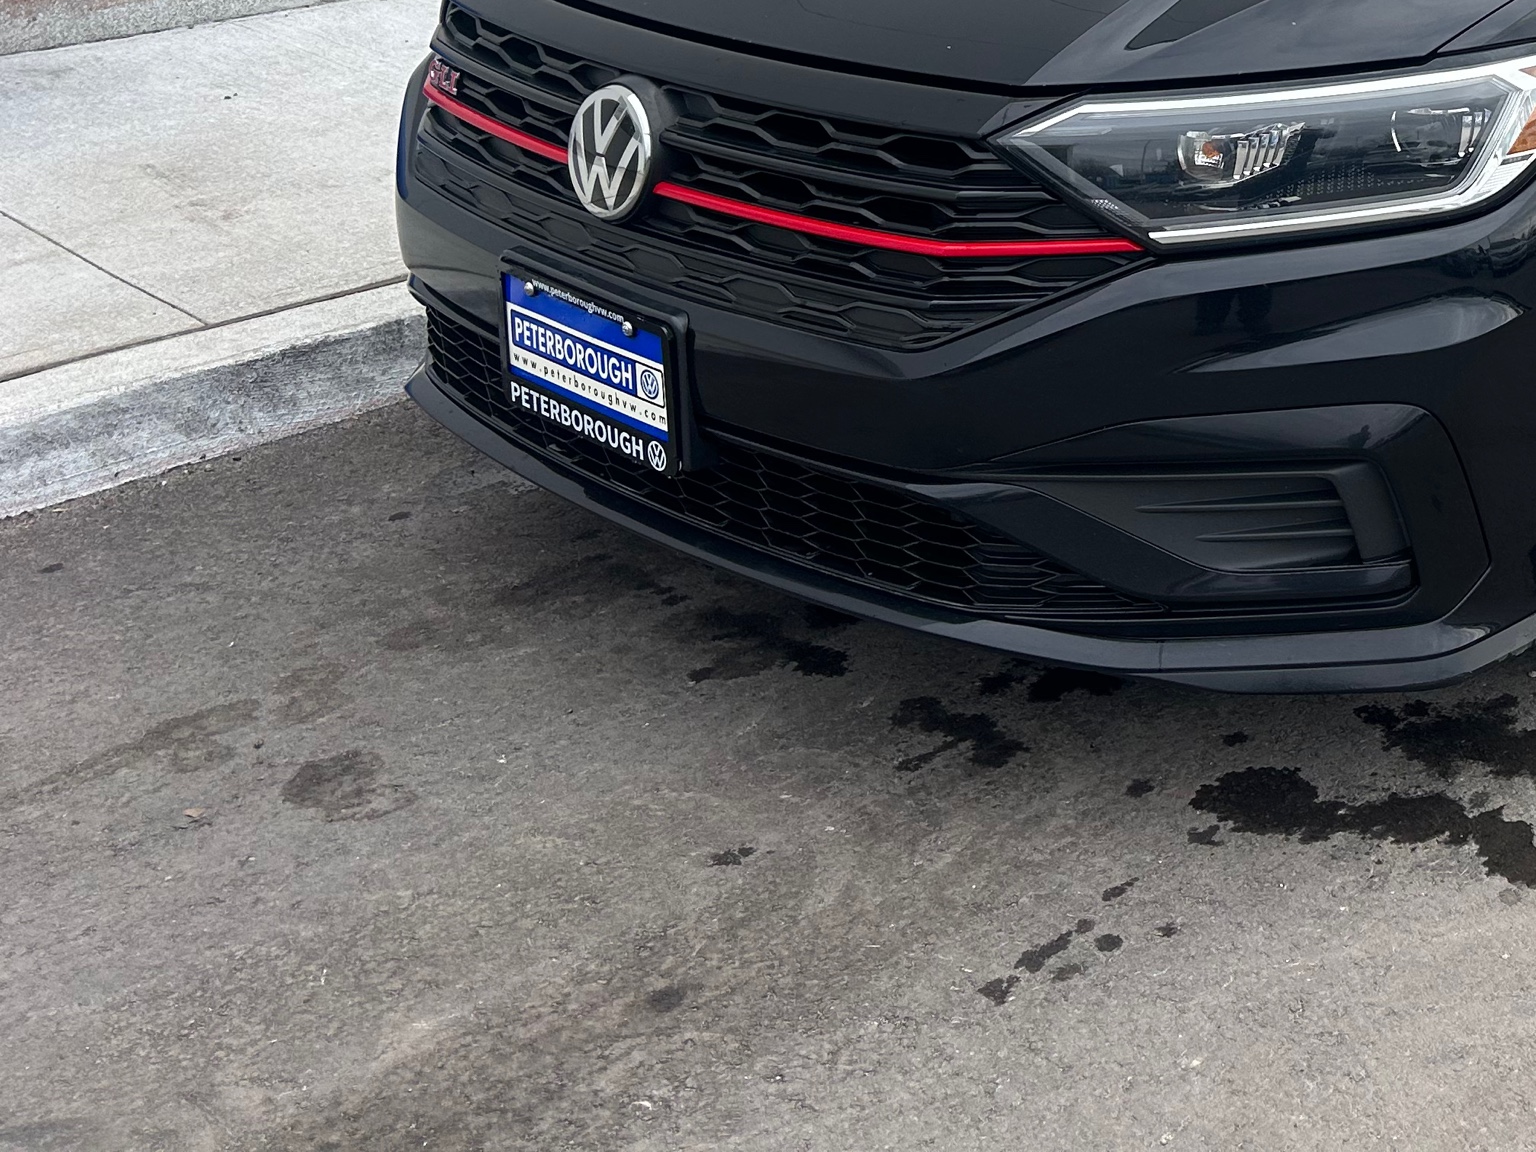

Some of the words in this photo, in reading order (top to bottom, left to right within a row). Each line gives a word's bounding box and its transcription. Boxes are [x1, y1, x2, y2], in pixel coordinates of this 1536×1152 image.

[428, 58, 461, 96] GLI
[531, 278, 625, 323] www.peterboroughvw.com
[514, 316, 634, 391] PETERBOROUGH
[510, 381, 645, 462] PETERBOROUGH
